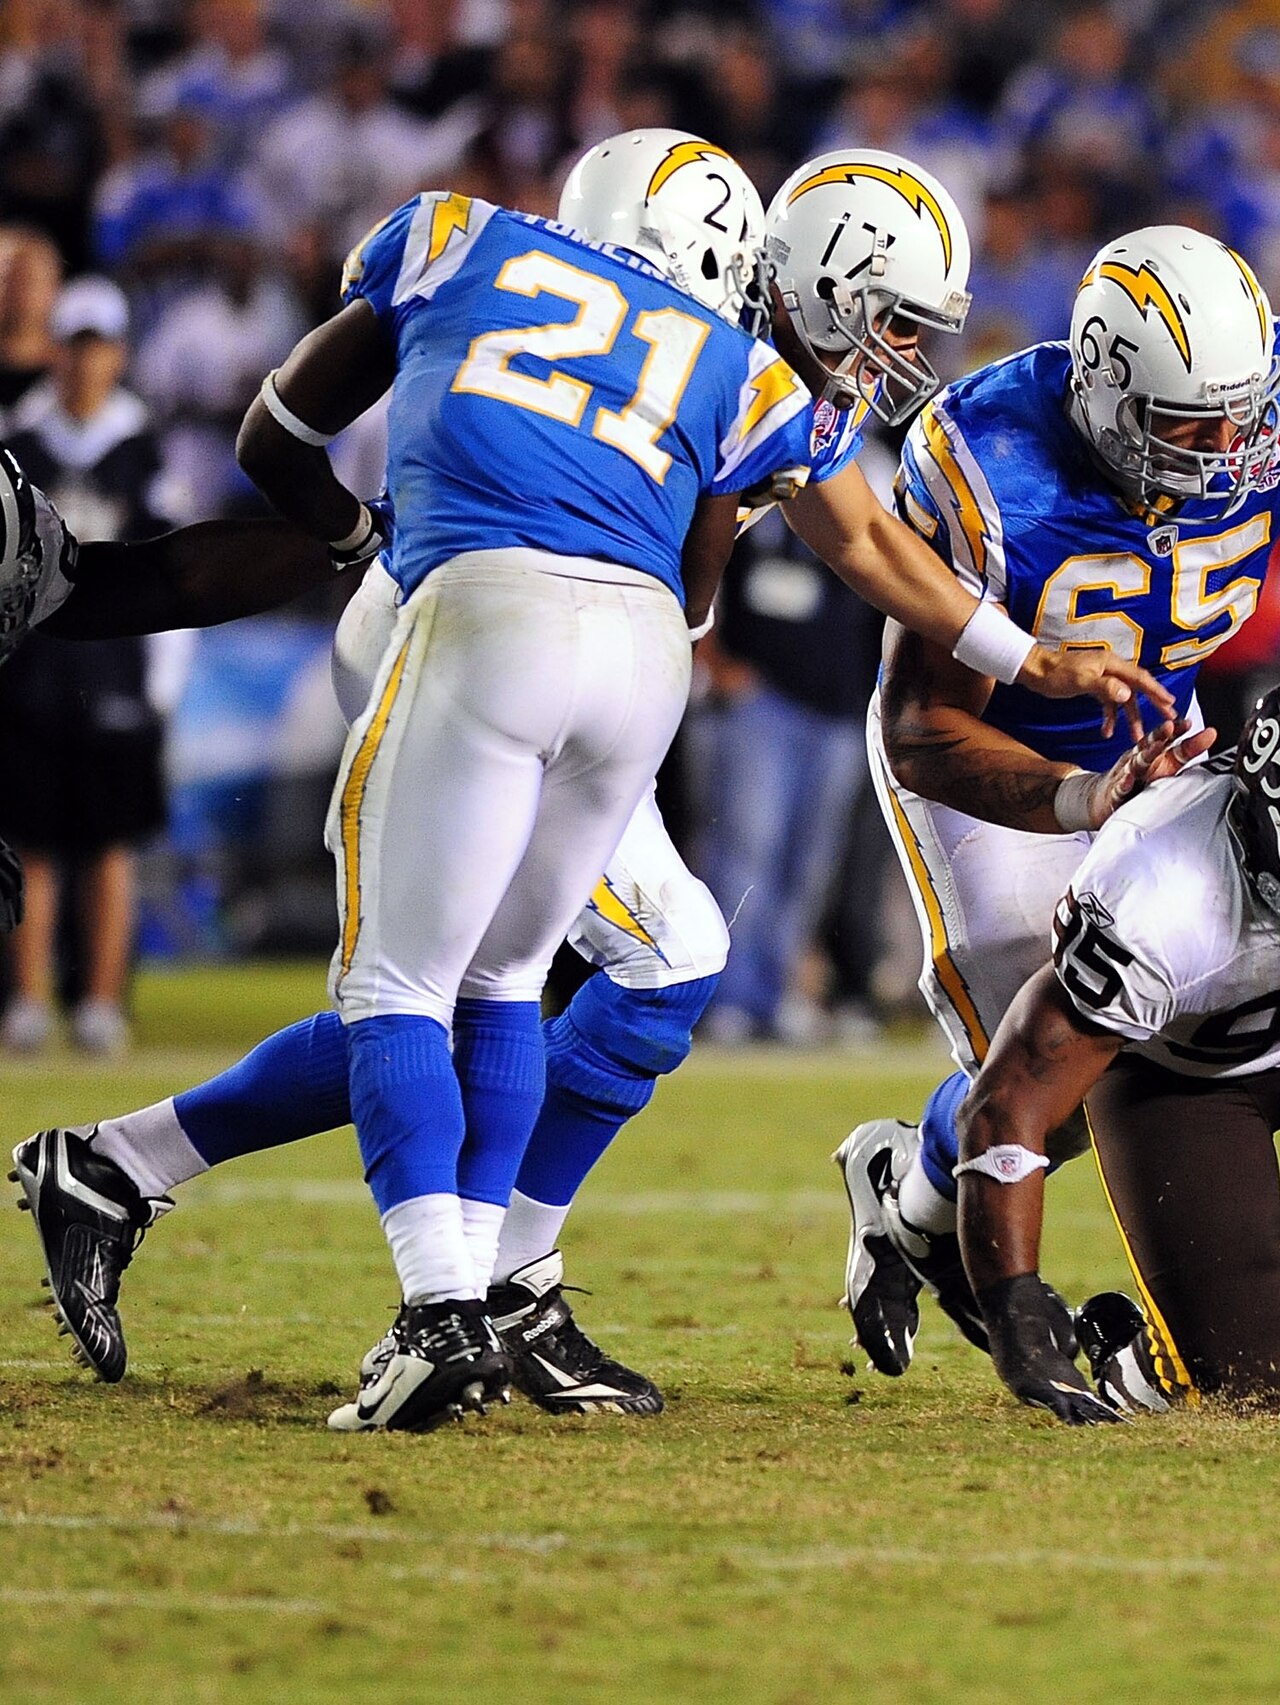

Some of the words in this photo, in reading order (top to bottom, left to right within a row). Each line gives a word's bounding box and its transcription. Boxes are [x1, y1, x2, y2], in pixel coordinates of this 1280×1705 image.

[820, 212, 896, 280] 17
[450, 249, 712, 486] 21
[1081, 315, 1140, 391] 65
[1032, 511, 1272, 671] 65
[522, 1309, 562, 1342] Reebok
